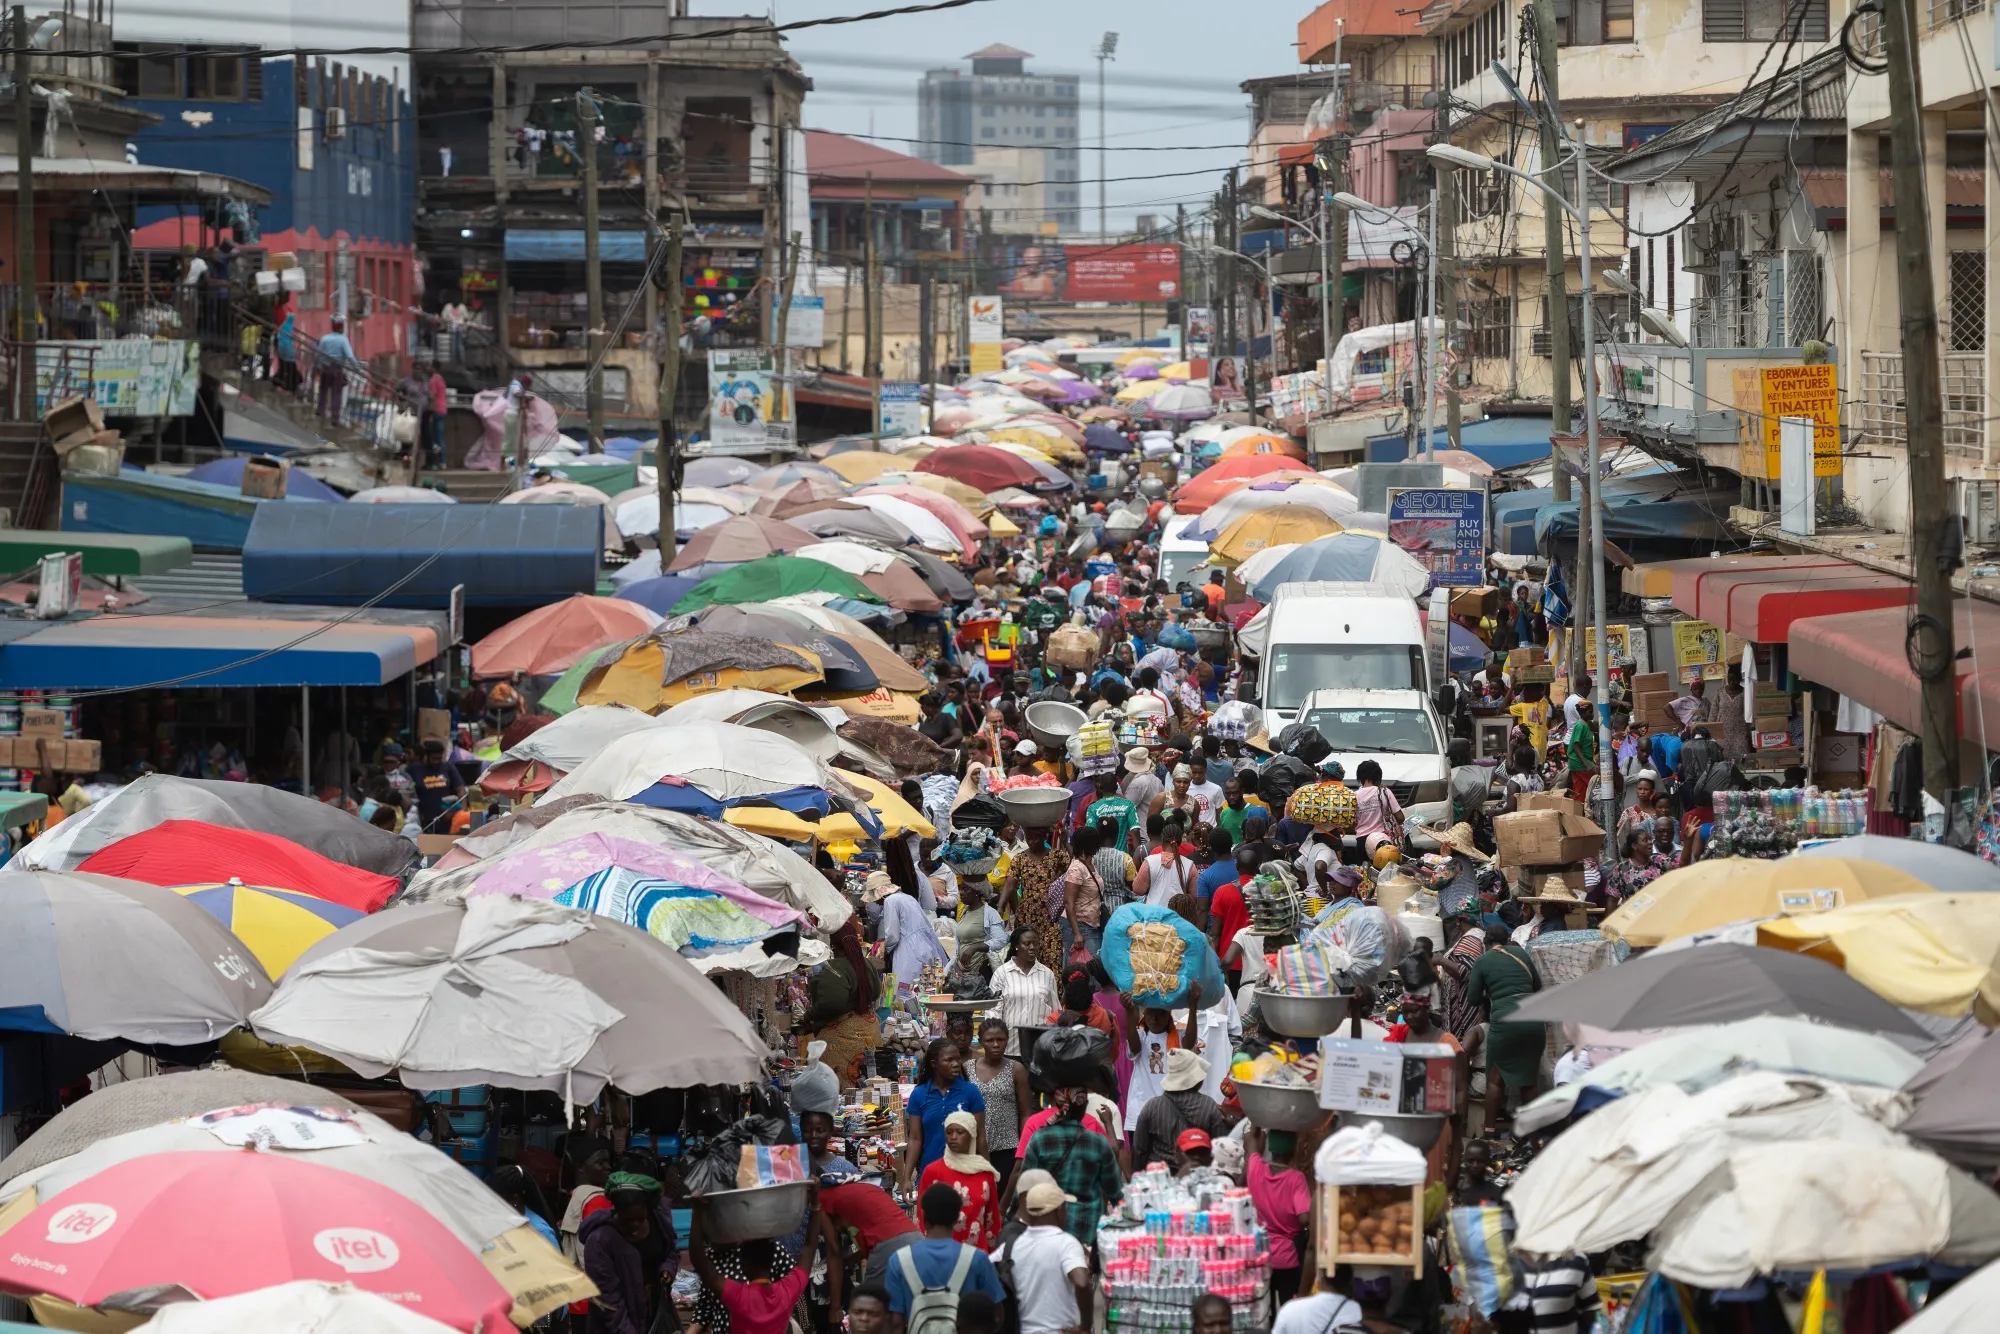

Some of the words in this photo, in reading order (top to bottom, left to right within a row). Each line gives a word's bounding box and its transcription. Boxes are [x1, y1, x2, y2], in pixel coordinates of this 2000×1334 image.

[1766, 366, 1830, 380] EBORWALEH
[1772, 378, 1830, 391] VENTURES
[1768, 392, 1780, 400] KEY
[1782, 390, 1828, 399] DISTRIBUTOR
[1769, 399, 1834, 414] TINATETT
[1394, 492, 1474, 509] GEOTEL
[1459, 520, 1479, 528] BUY
[1457, 530, 1480, 538] AND
[1456, 540, 1482, 549] SELL
[56, 1208, 109, 1236] itel
[328, 1235, 388, 1260] itel
[10, 1252, 32, 1268] Enjoy
[31, 1257, 55, 1272] better
[53, 1263, 68, 1276] life
